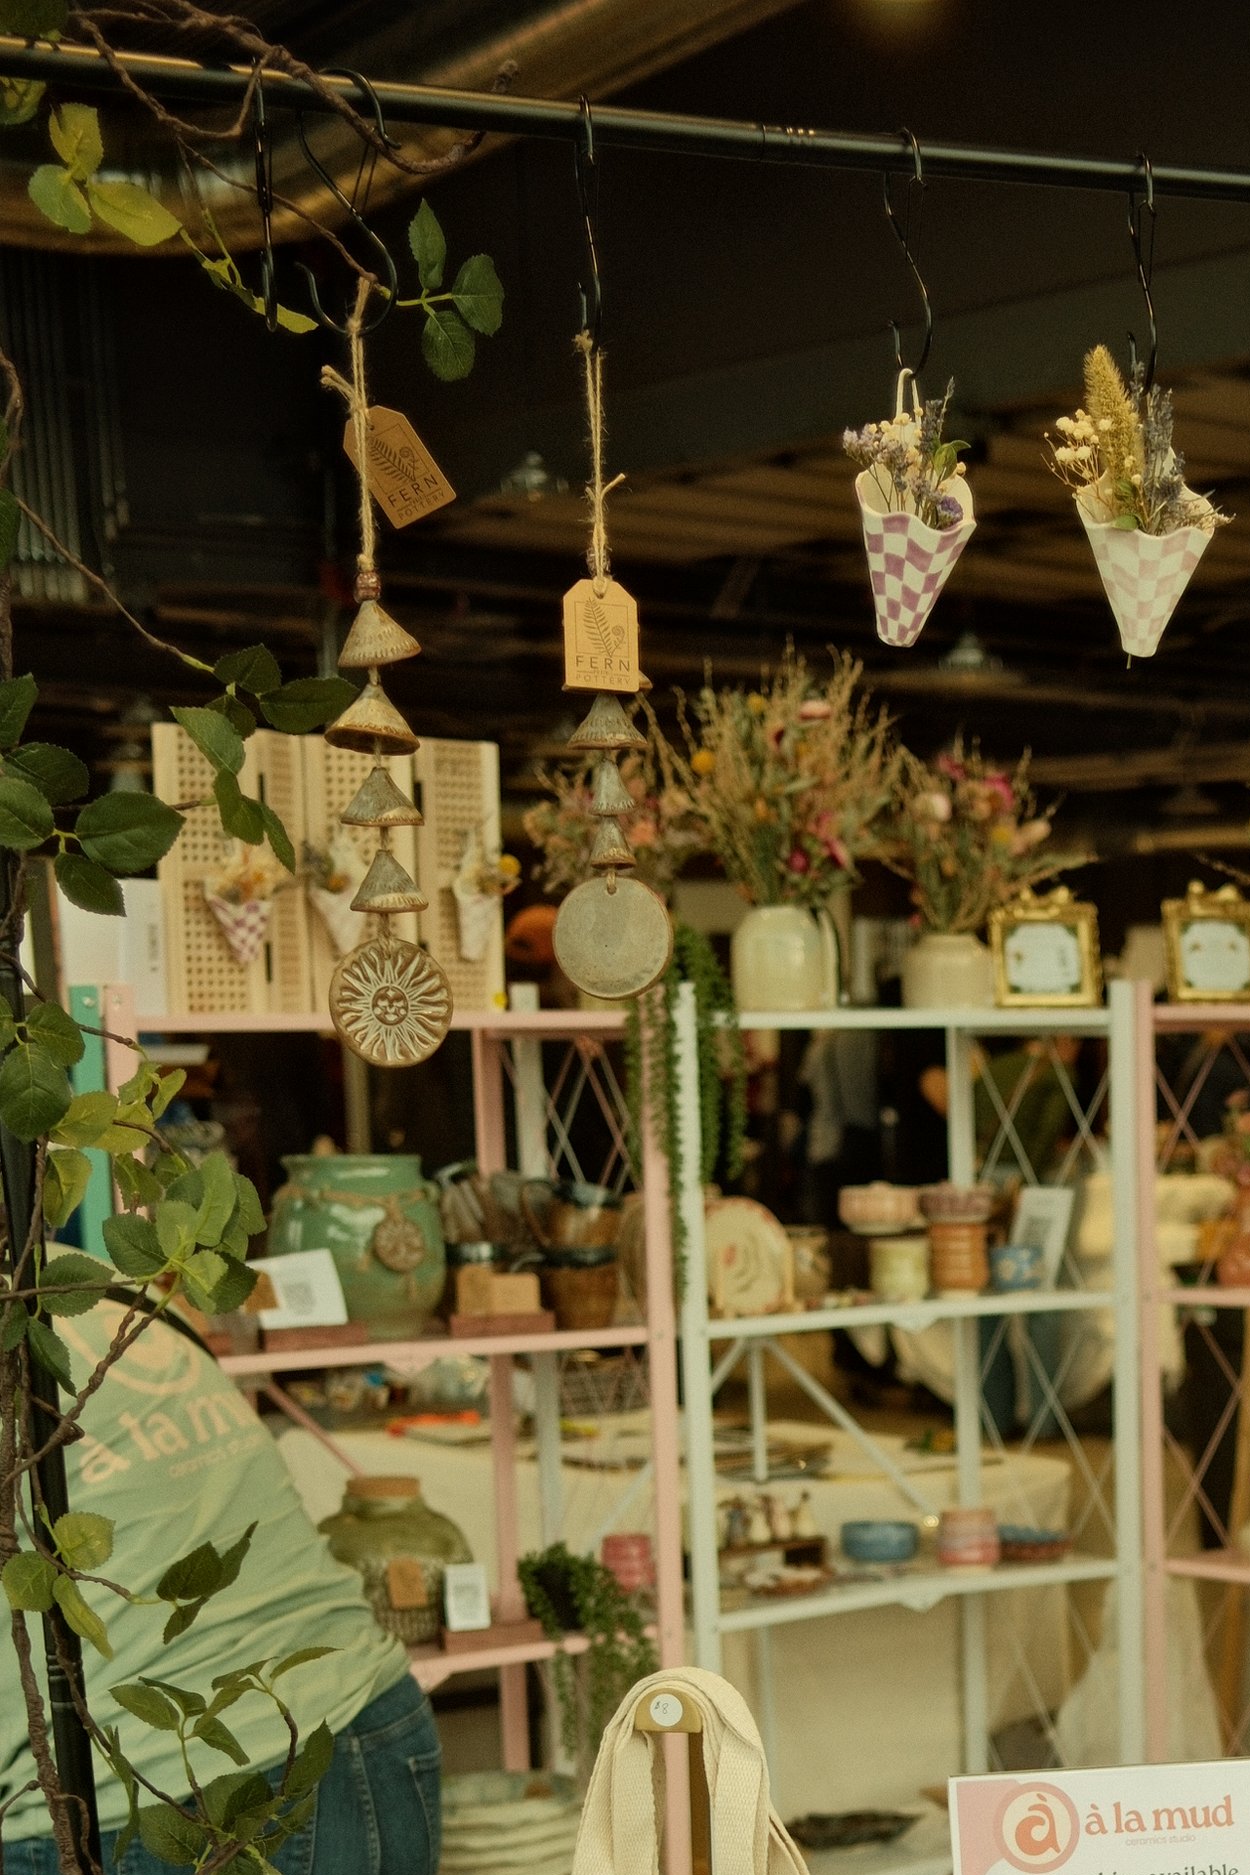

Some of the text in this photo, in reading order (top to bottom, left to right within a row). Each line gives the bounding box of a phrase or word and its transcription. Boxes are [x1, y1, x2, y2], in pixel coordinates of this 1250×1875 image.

[386, 474, 438, 508] FERN
[398, 492, 446, 520] POTTERY
[575, 655, 630, 672] FERN
[576, 674, 631, 684] POTTERY
[118, 1410, 189, 1461] la
[654, 1701, 669, 1715] $8
[1084, 1794, 1236, 1836] à la mud
[1124, 1833, 1197, 1848] ceramics studio
